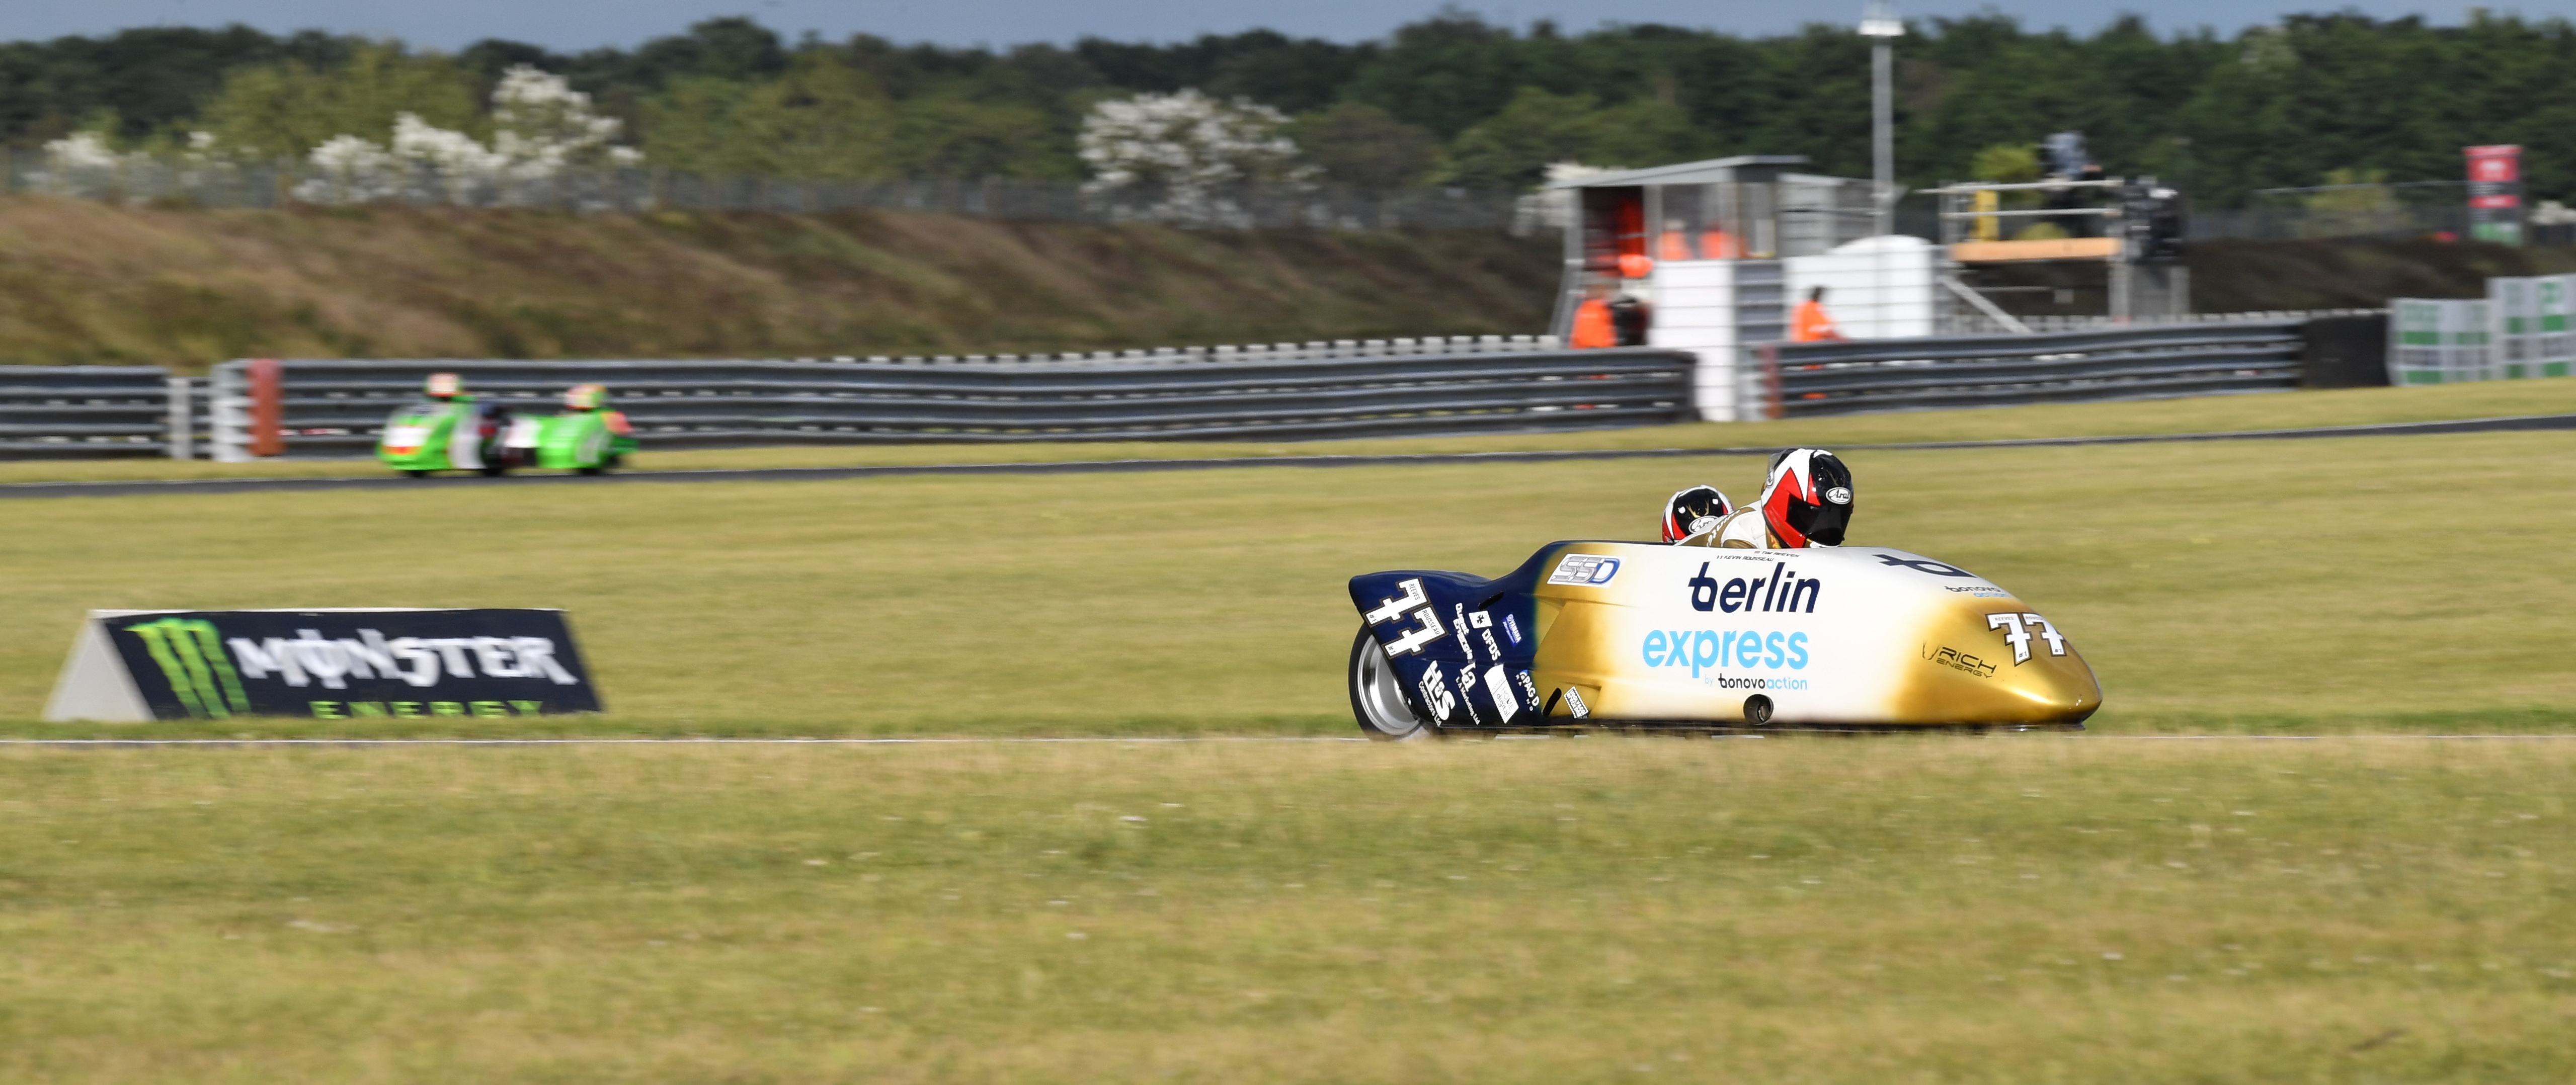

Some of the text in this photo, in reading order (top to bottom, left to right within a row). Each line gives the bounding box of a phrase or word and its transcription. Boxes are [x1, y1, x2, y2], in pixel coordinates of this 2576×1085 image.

[1550, 556, 1621, 585] SSD
[1409, 583, 1420, 601] REEVES
[1687, 561, 1821, 613] berlin
[1363, 577, 1449, 659] 77
[1422, 610, 1440, 635] ROUSSEAU
[1509, 619, 1522, 644] YAMAHA
[1482, 628, 1501, 661] DFDS
[1642, 629, 1809, 679] express
[1985, 612, 2067, 667] 77
[226, 629, 579, 689] MONSTER
[1936, 657, 1993, 679] ENERGY
[1939, 646, 1997, 674] RICH
[1418, 681, 1442, 726] Contractors Ltd
[1422, 660, 1456, 720] H&S
[1460, 687, 1475, 716] Marketing
[308, 700, 544, 720] ENERGY
[1496, 693, 1510, 717] digital
